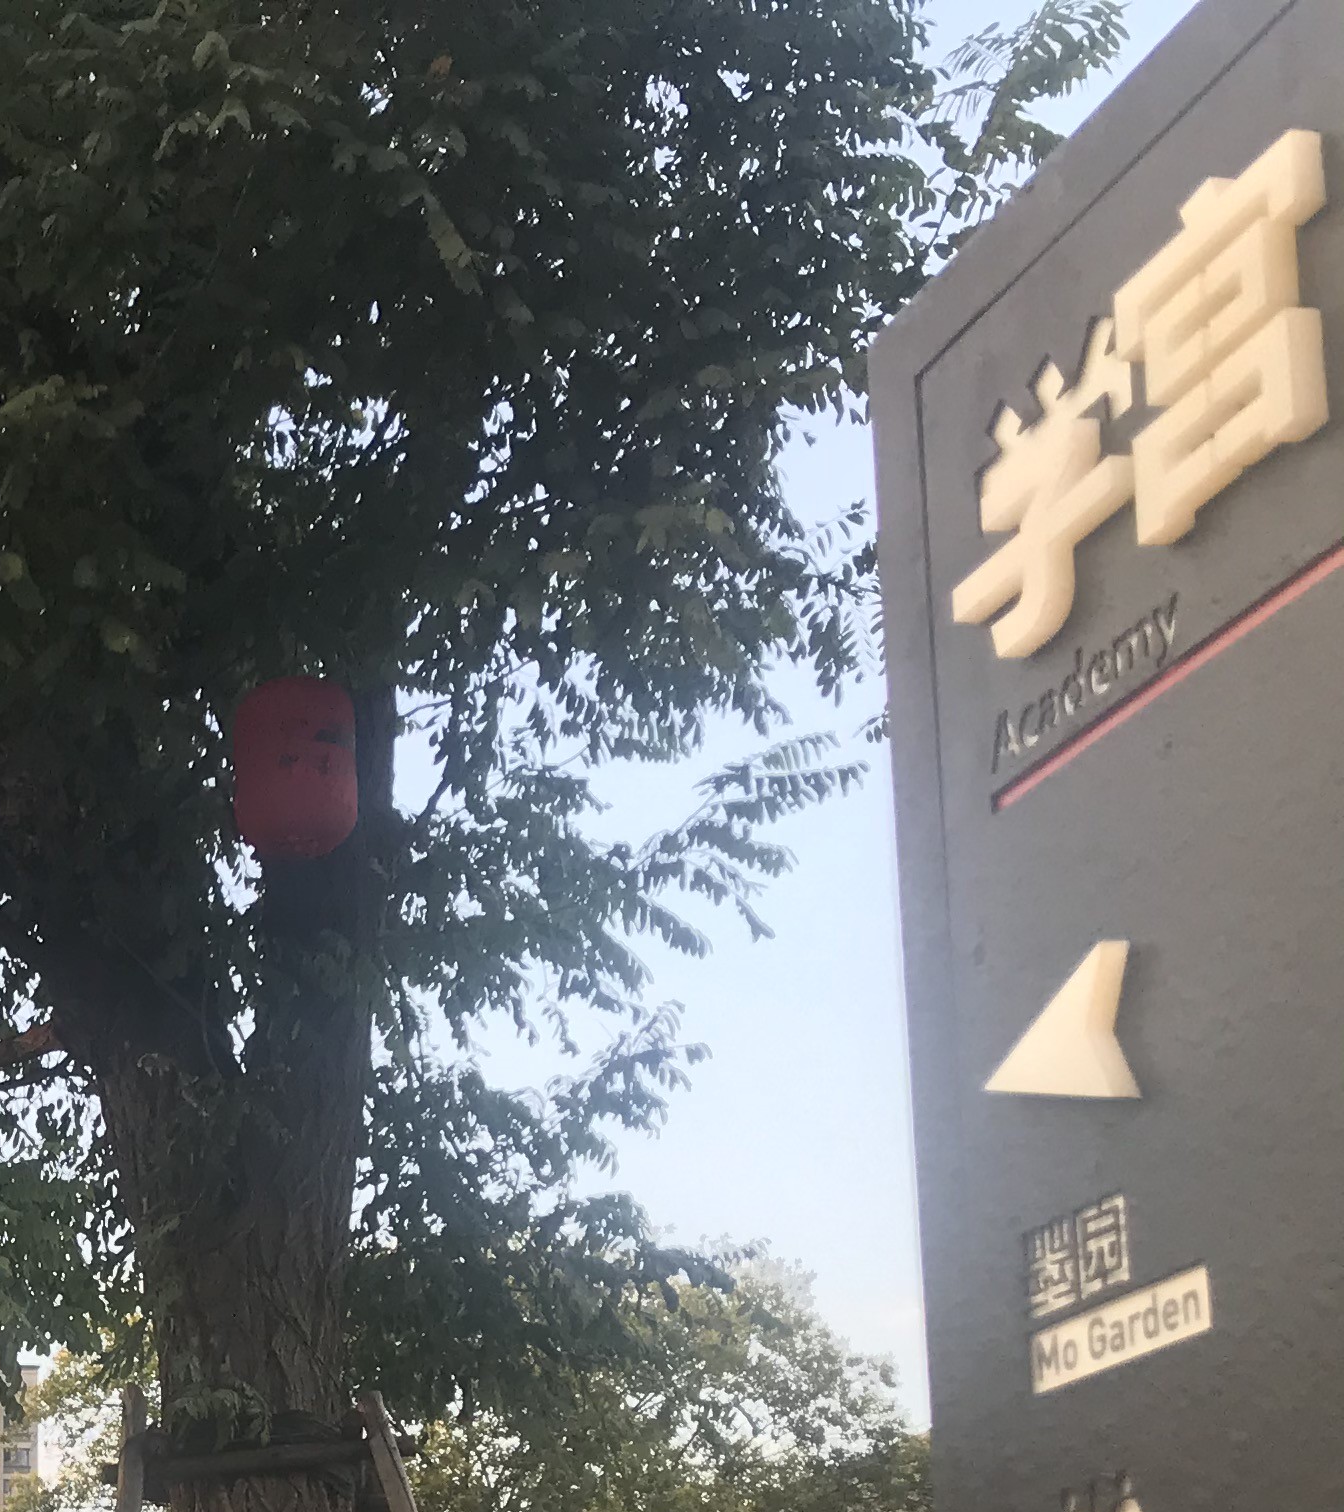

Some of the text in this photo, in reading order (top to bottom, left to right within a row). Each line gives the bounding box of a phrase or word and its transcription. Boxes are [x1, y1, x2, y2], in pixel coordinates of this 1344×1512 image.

[952, 128, 1330, 658] 学宫
[991, 590, 1179, 774] Academy
[1034, 1285, 1202, 1383] Mo Garden
